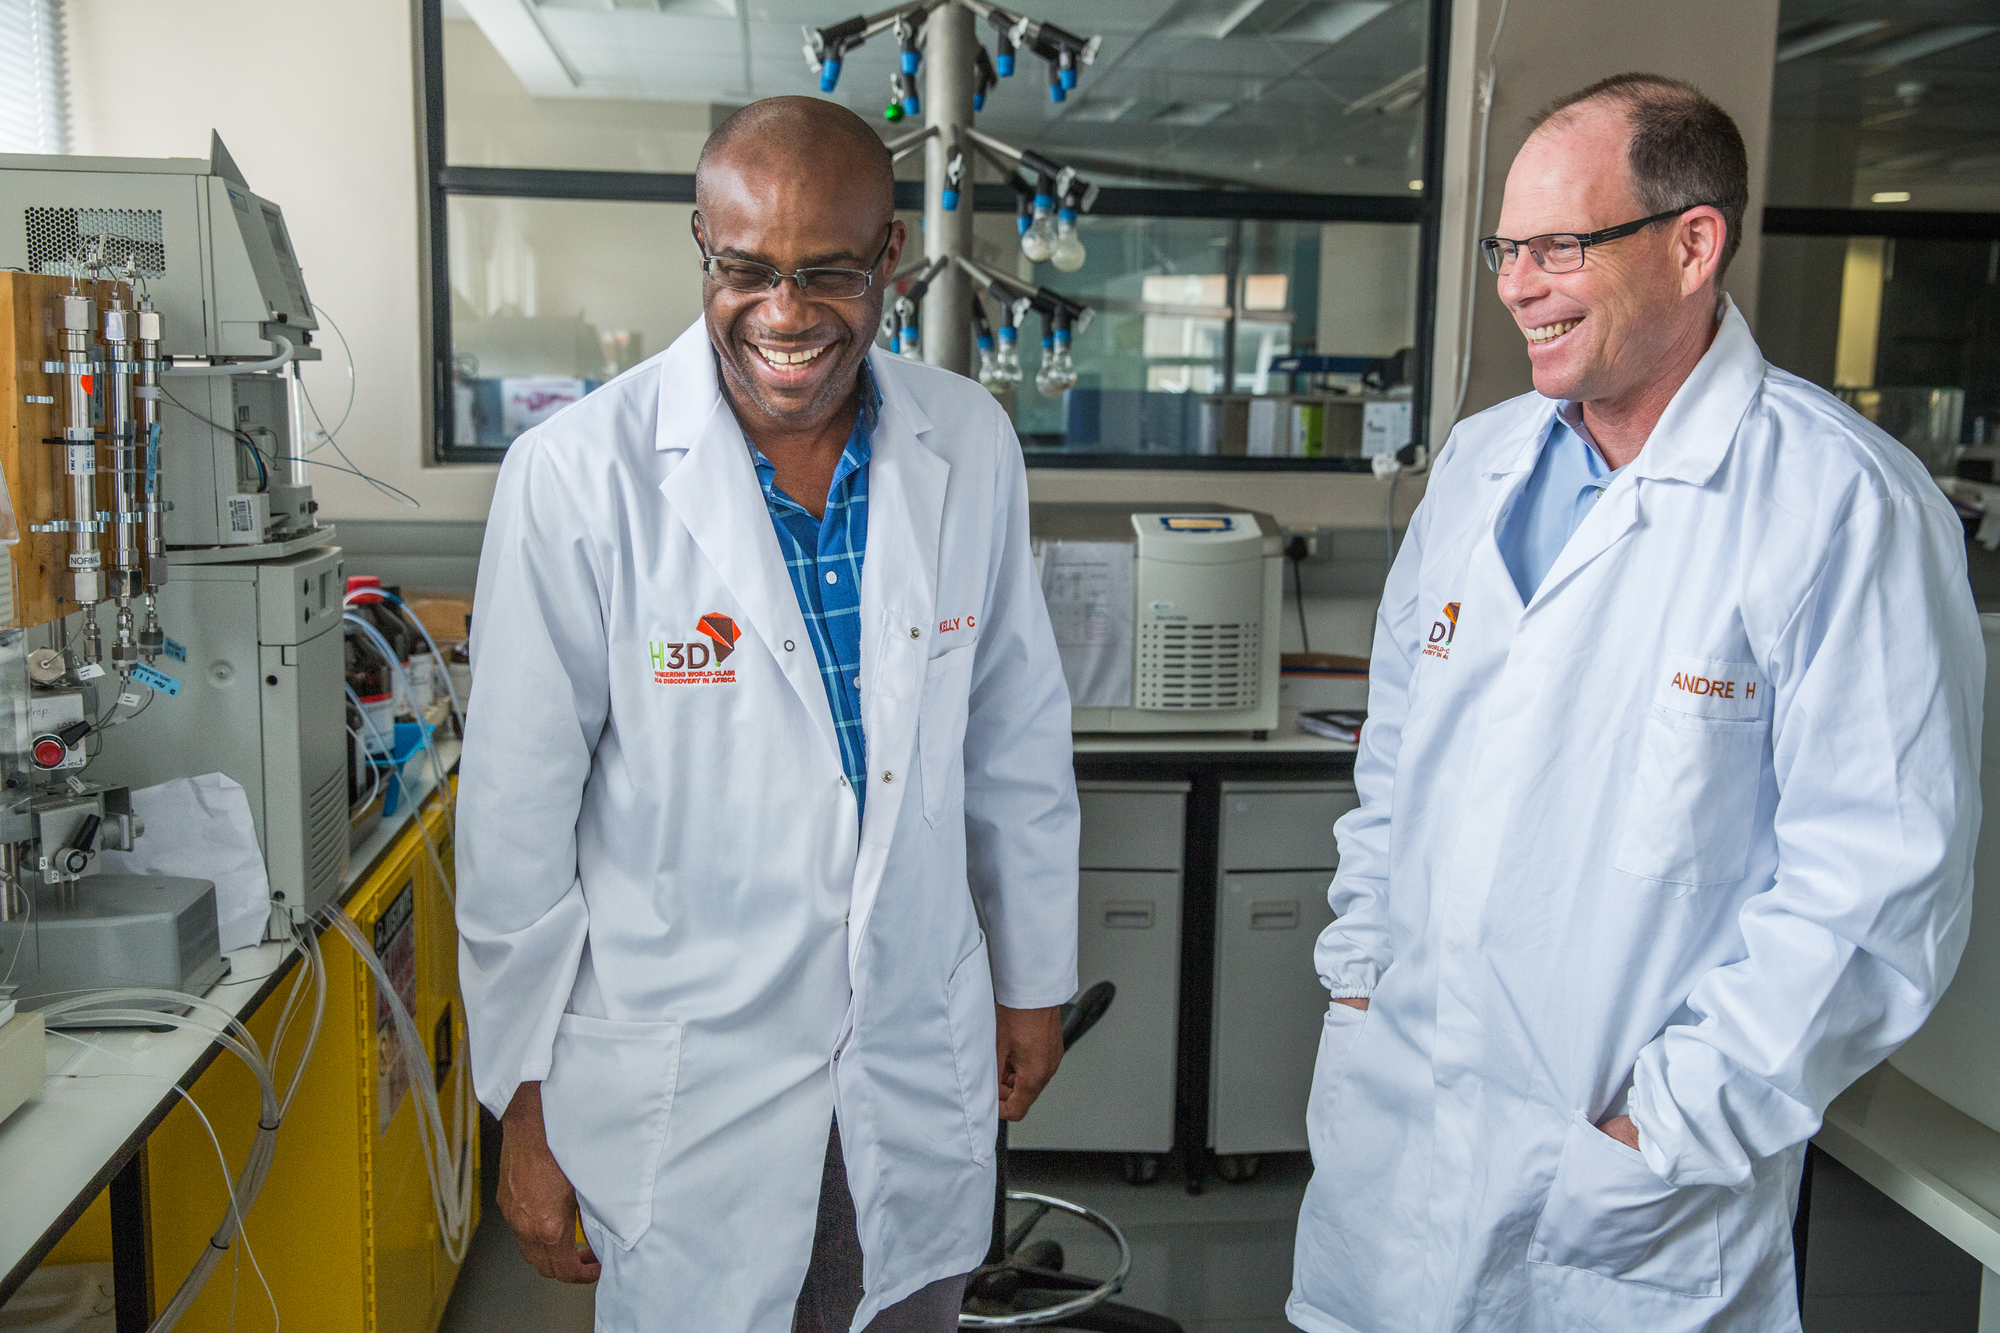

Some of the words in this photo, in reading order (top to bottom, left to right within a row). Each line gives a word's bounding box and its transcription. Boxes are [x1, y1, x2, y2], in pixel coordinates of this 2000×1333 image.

[939, 617, 960, 634] KELLY
[966, 615, 976, 628] C
[649, 641, 710, 670] H3D
[1671, 671, 1735, 699] ANDRE
[1745, 681, 1756, 699] H
[41, 859, 46, 867] 3
[53, 872, 58, 880] 2
